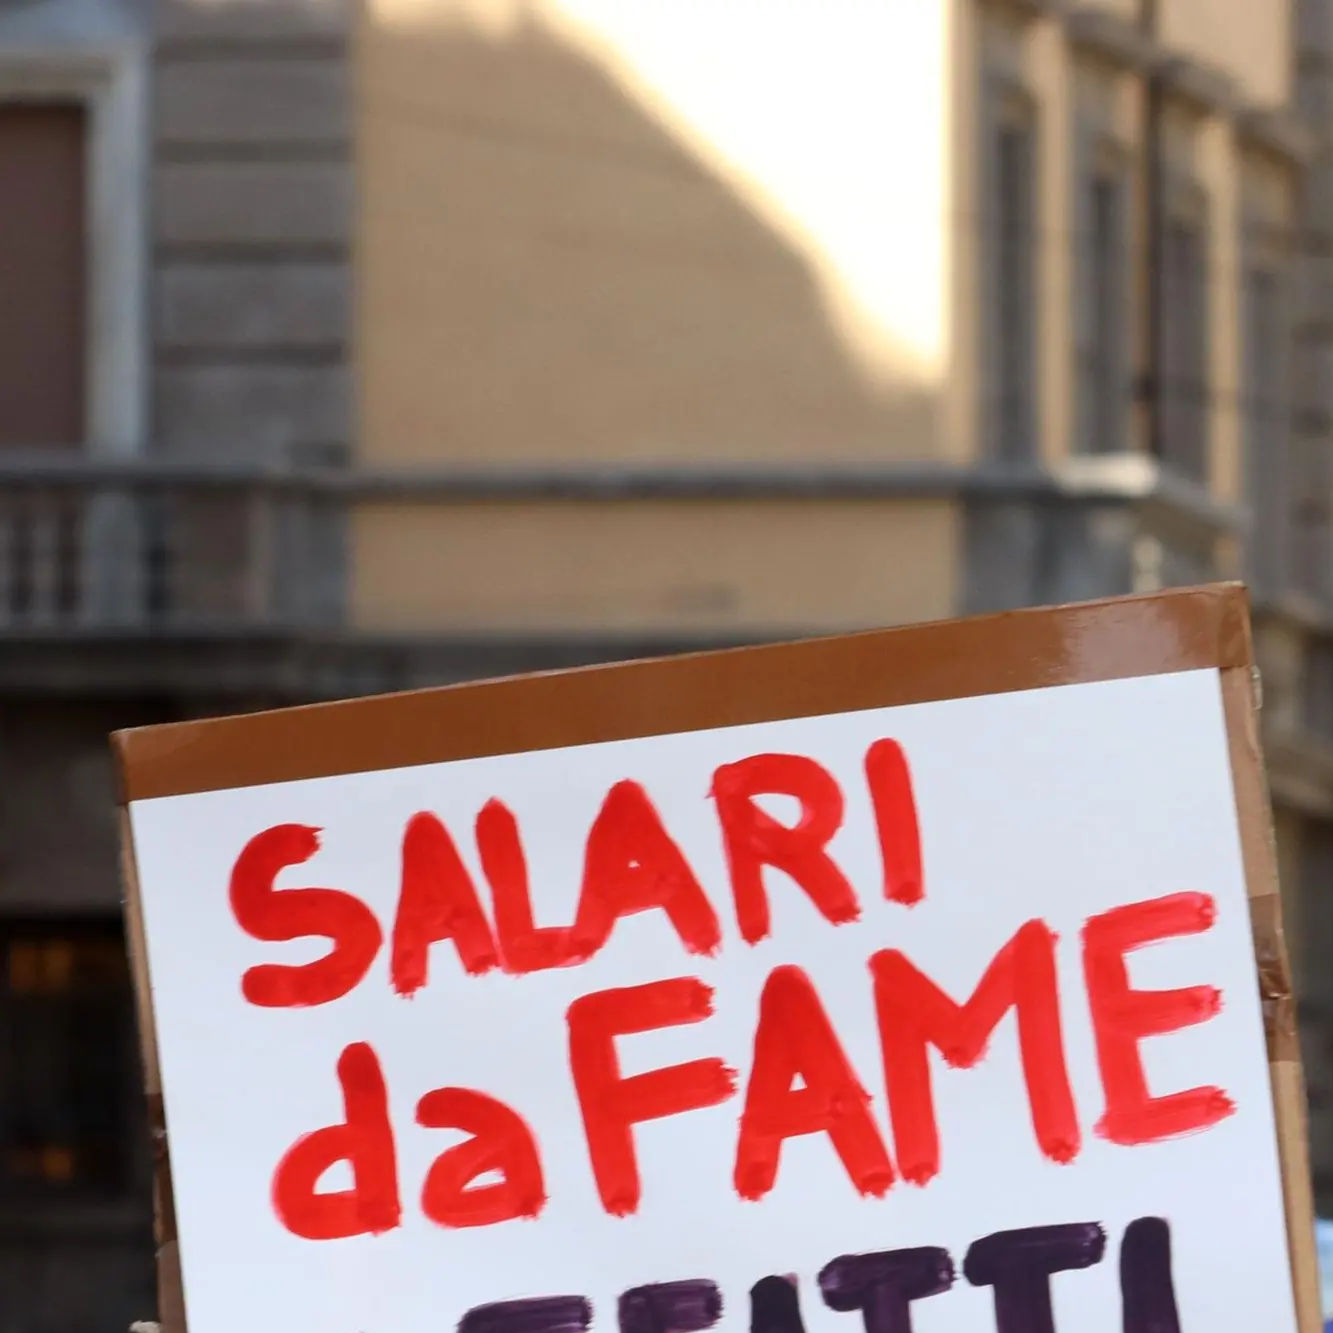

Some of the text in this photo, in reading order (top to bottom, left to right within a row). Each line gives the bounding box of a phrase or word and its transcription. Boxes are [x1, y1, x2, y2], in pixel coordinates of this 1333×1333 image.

[228, 738, 925, 1008] SALARI
[273, 893, 1236, 1240] da FAME
